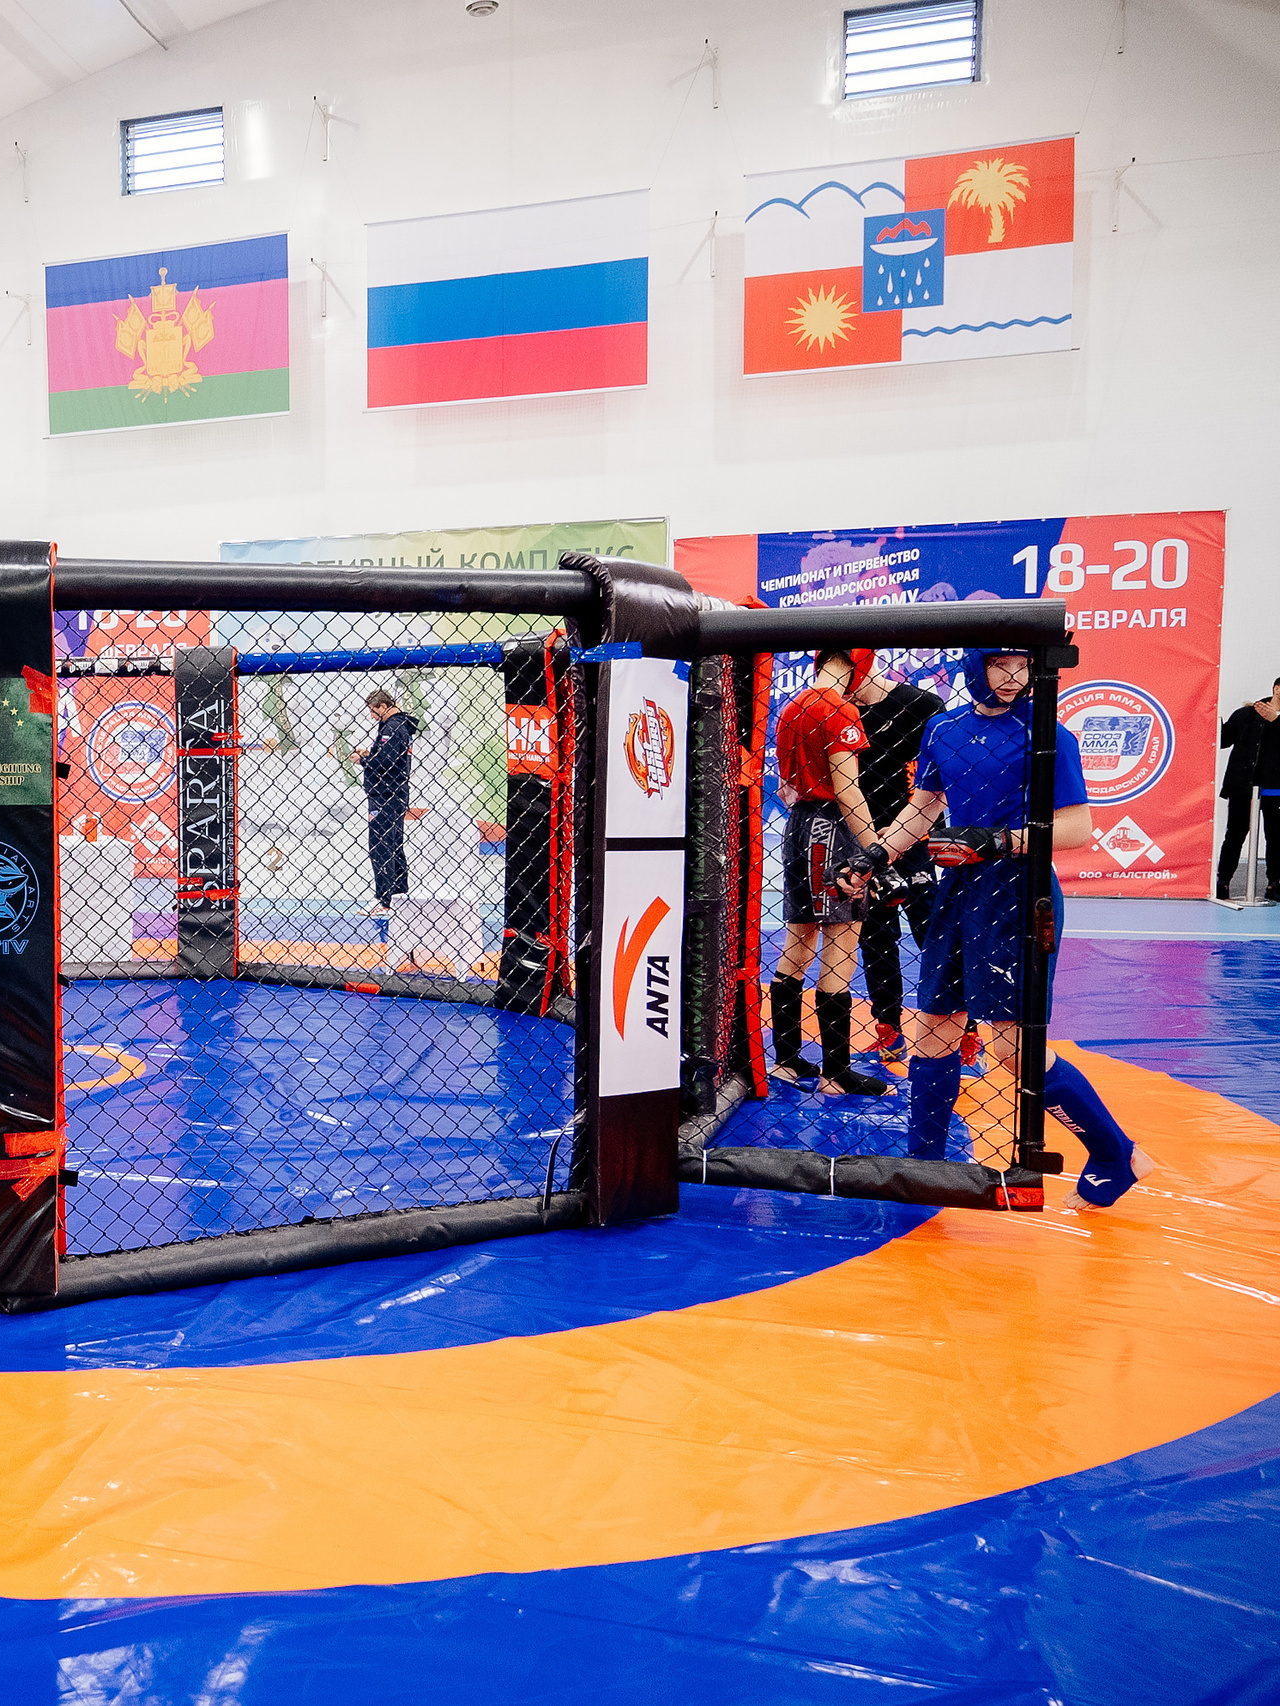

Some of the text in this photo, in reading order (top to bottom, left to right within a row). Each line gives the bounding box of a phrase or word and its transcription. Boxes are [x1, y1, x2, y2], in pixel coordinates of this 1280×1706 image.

[760, 548, 920, 593] ЧЕМПИОНАТ И ПЕРВЕНСТВО
[1012, 538, 1190, 594] 18-20
[779, 575, 888, 608] КРАСНОДАРСКОГО
[888, 568, 920, 586] КРАЯ
[1057, 692, 1142, 722] РАЦИЯ ММА
[1081, 740, 1119, 748] ММА
[1083, 732, 1123, 740] СОЮЗ
[1086, 736, 1160, 794] НОДАРСКИЙ КРАЙ
[1078, 869, 1178, 880] ООО «БАЛСТРОЙ»
[11, 885, 36, 933] ARTS
[646, 954, 671, 1039] ANTA
